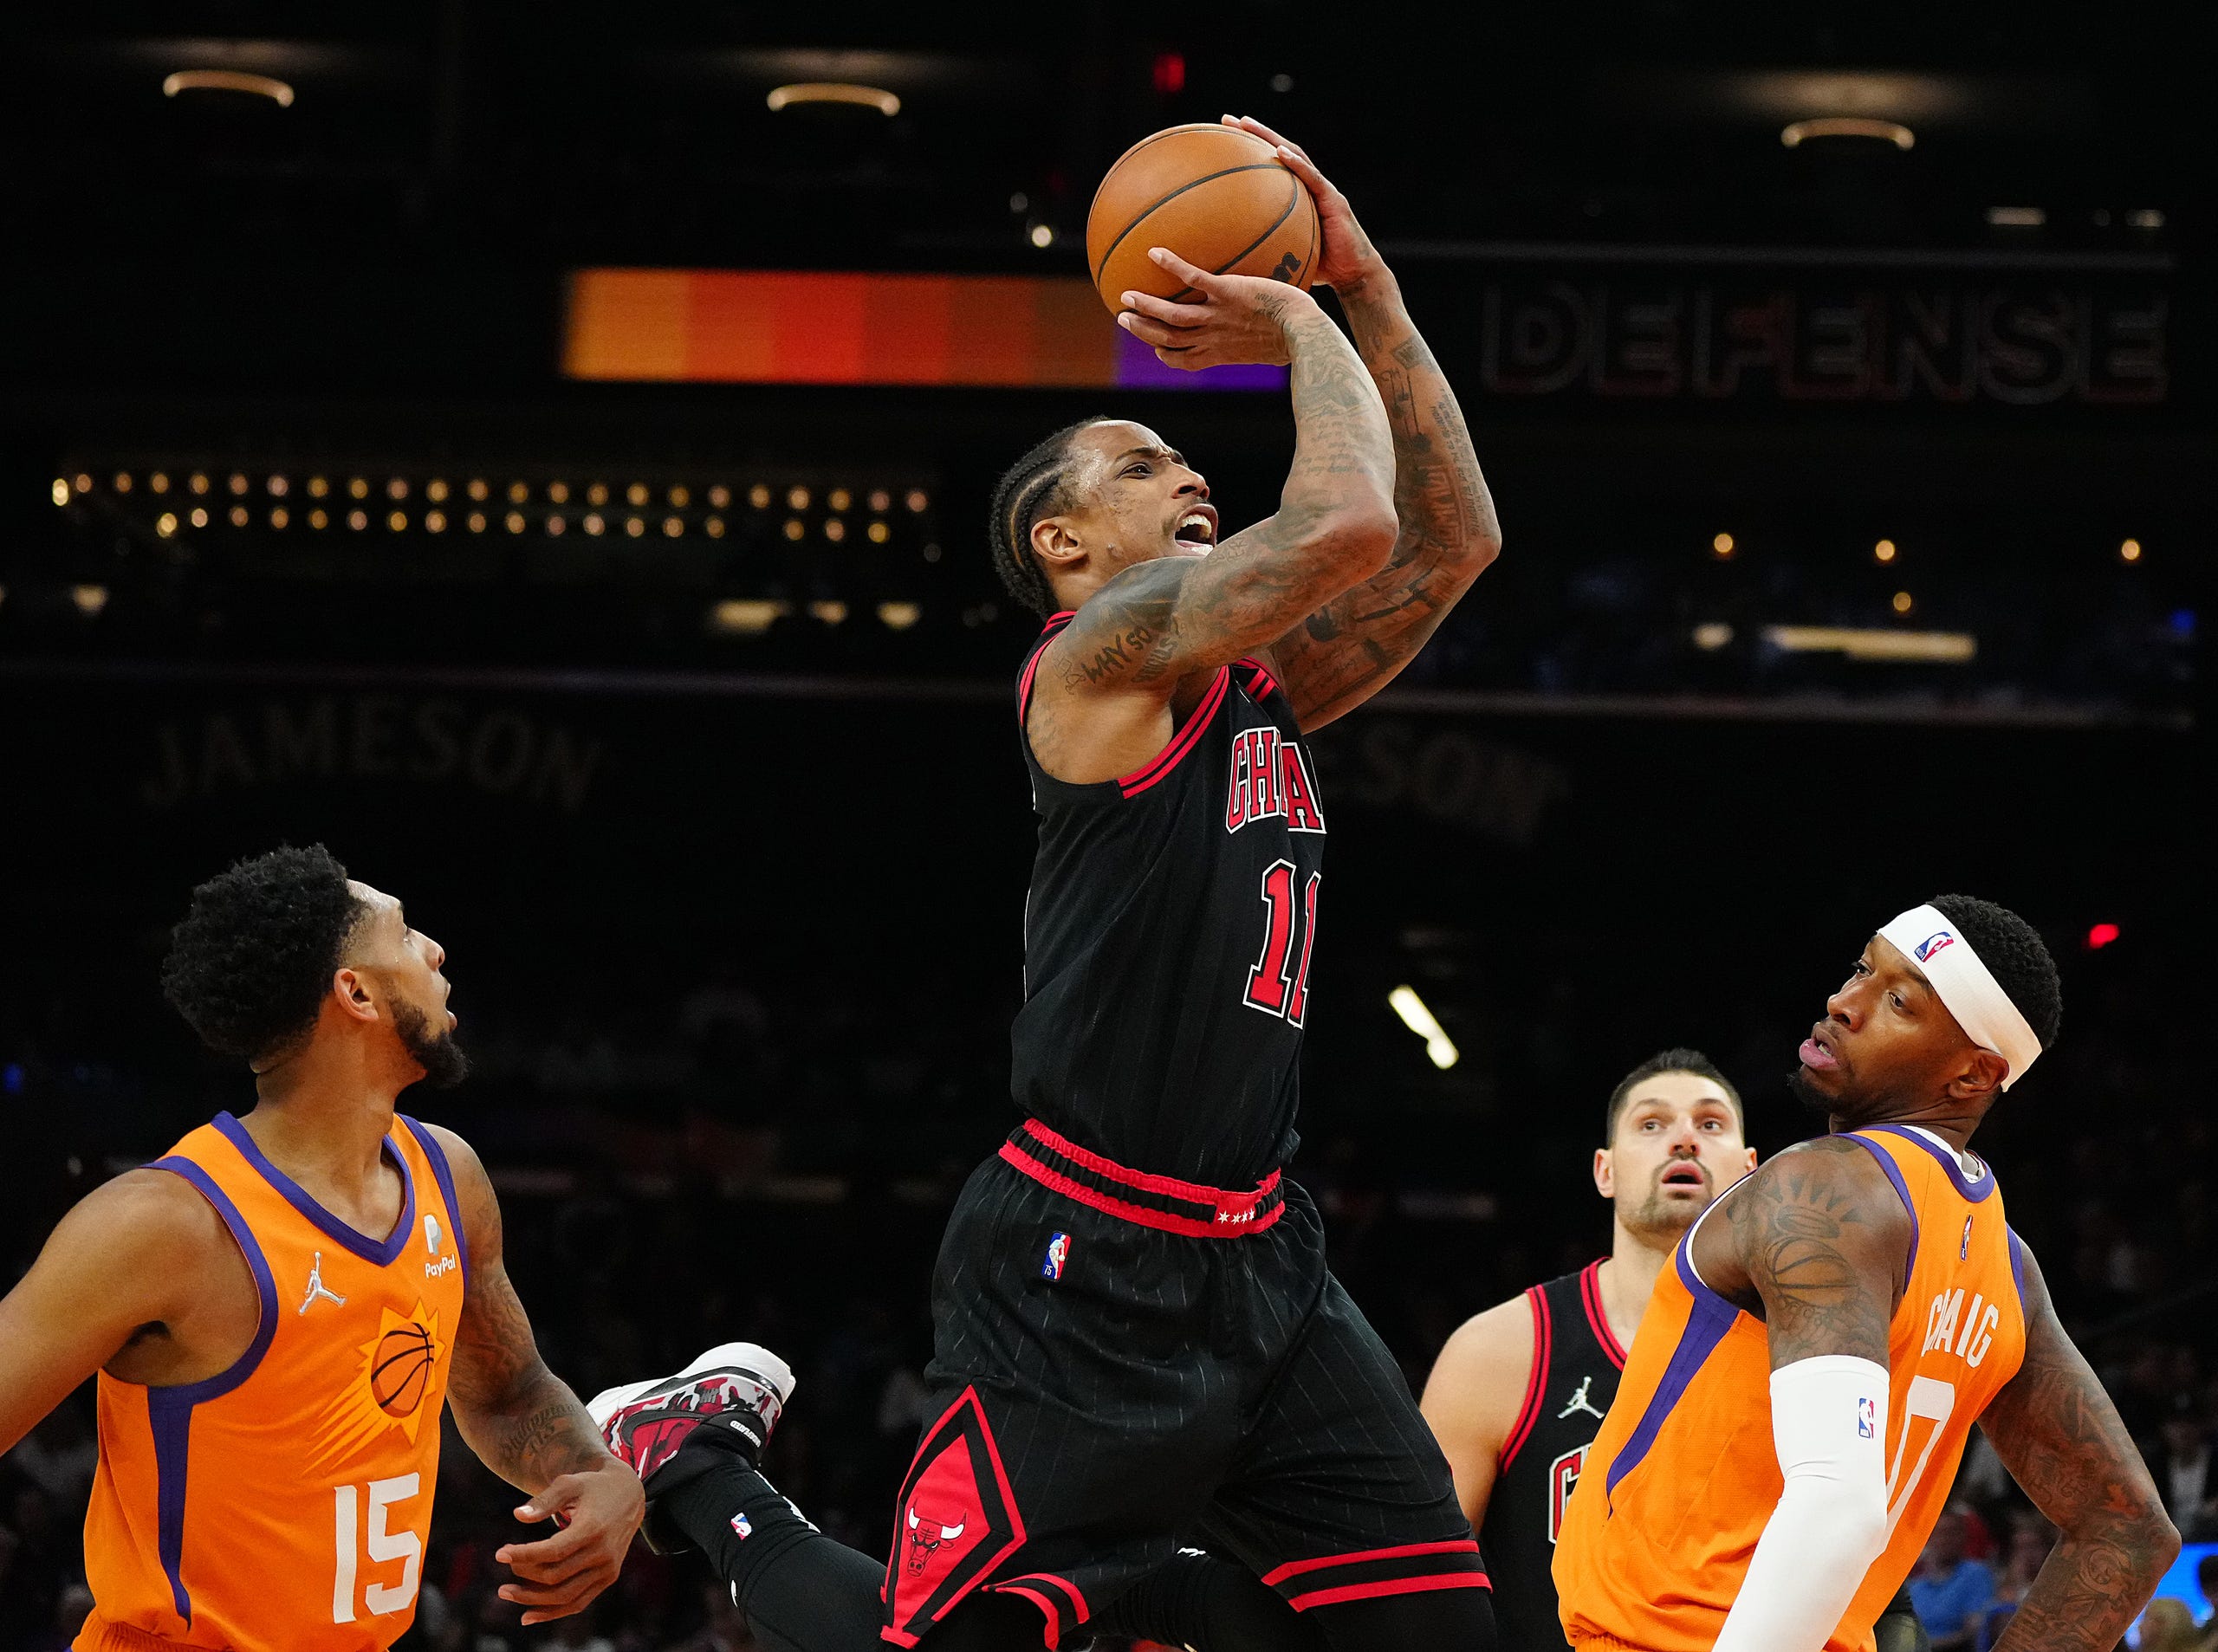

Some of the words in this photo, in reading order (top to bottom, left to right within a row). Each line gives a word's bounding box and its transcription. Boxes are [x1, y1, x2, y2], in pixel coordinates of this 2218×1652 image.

[1481, 279, 2169, 405] DEFENSE
[139, 691, 605, 818] JAMESON
[425, 1253, 456, 1279] PayPal
[334, 1472, 421, 1623] 15
